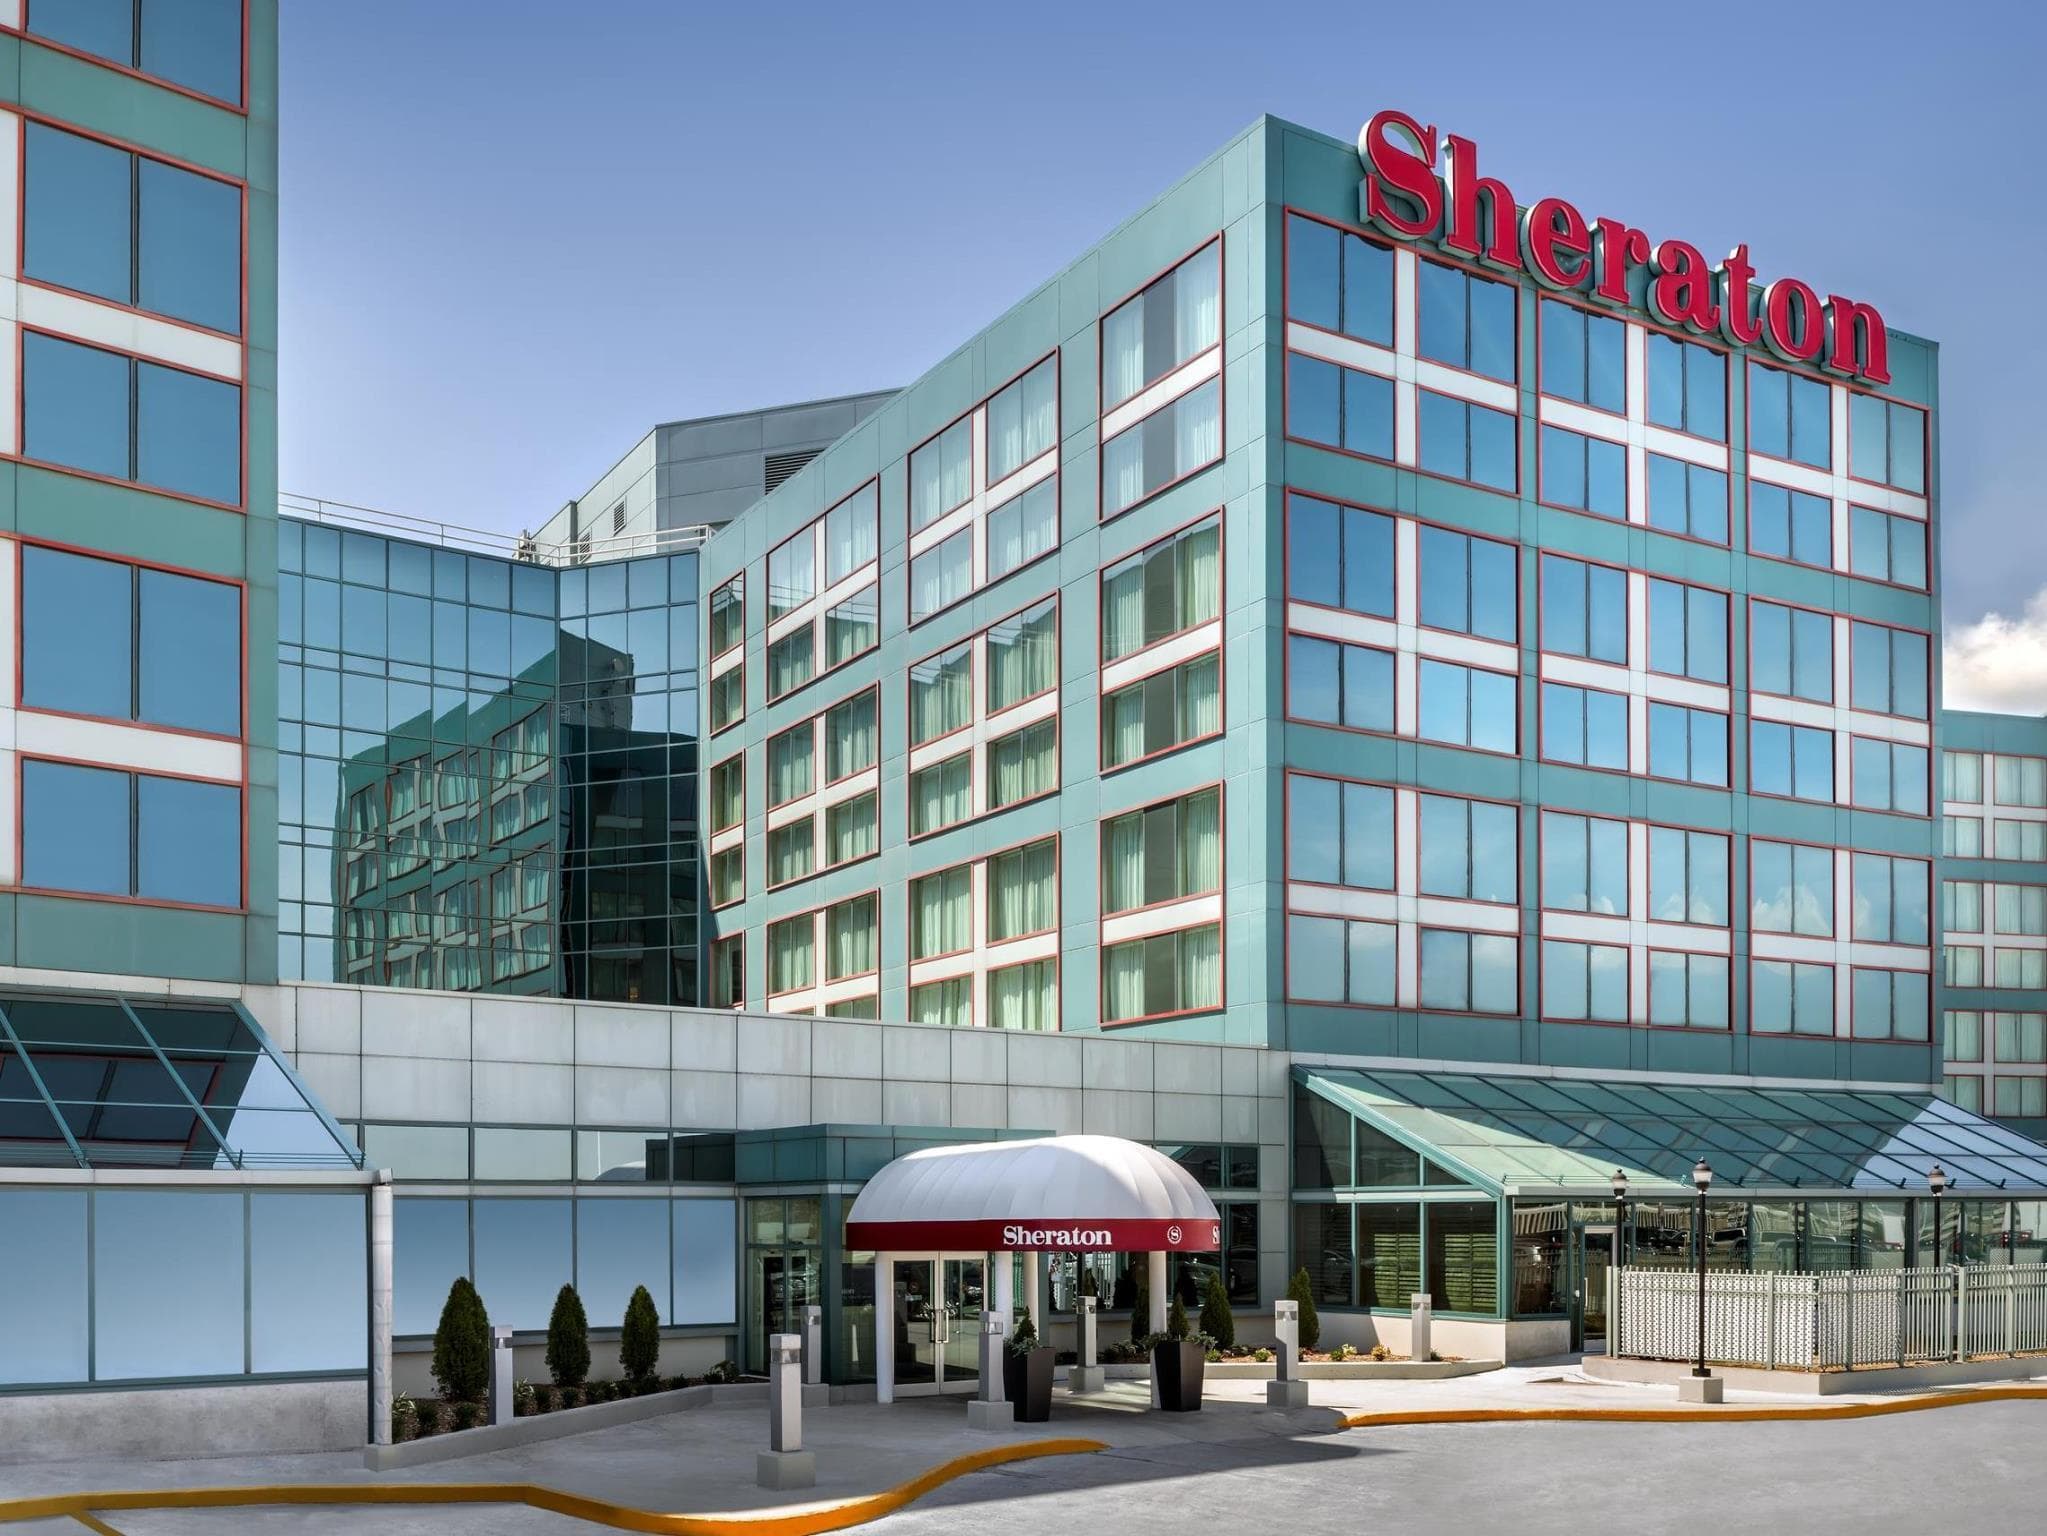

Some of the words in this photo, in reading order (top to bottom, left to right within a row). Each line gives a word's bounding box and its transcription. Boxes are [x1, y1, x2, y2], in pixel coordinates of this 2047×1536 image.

[1359, 110, 1891, 385] Sheraton
[1003, 1225, 1112, 1246] Sheraton
[1168, 1226, 1181, 1243] S
